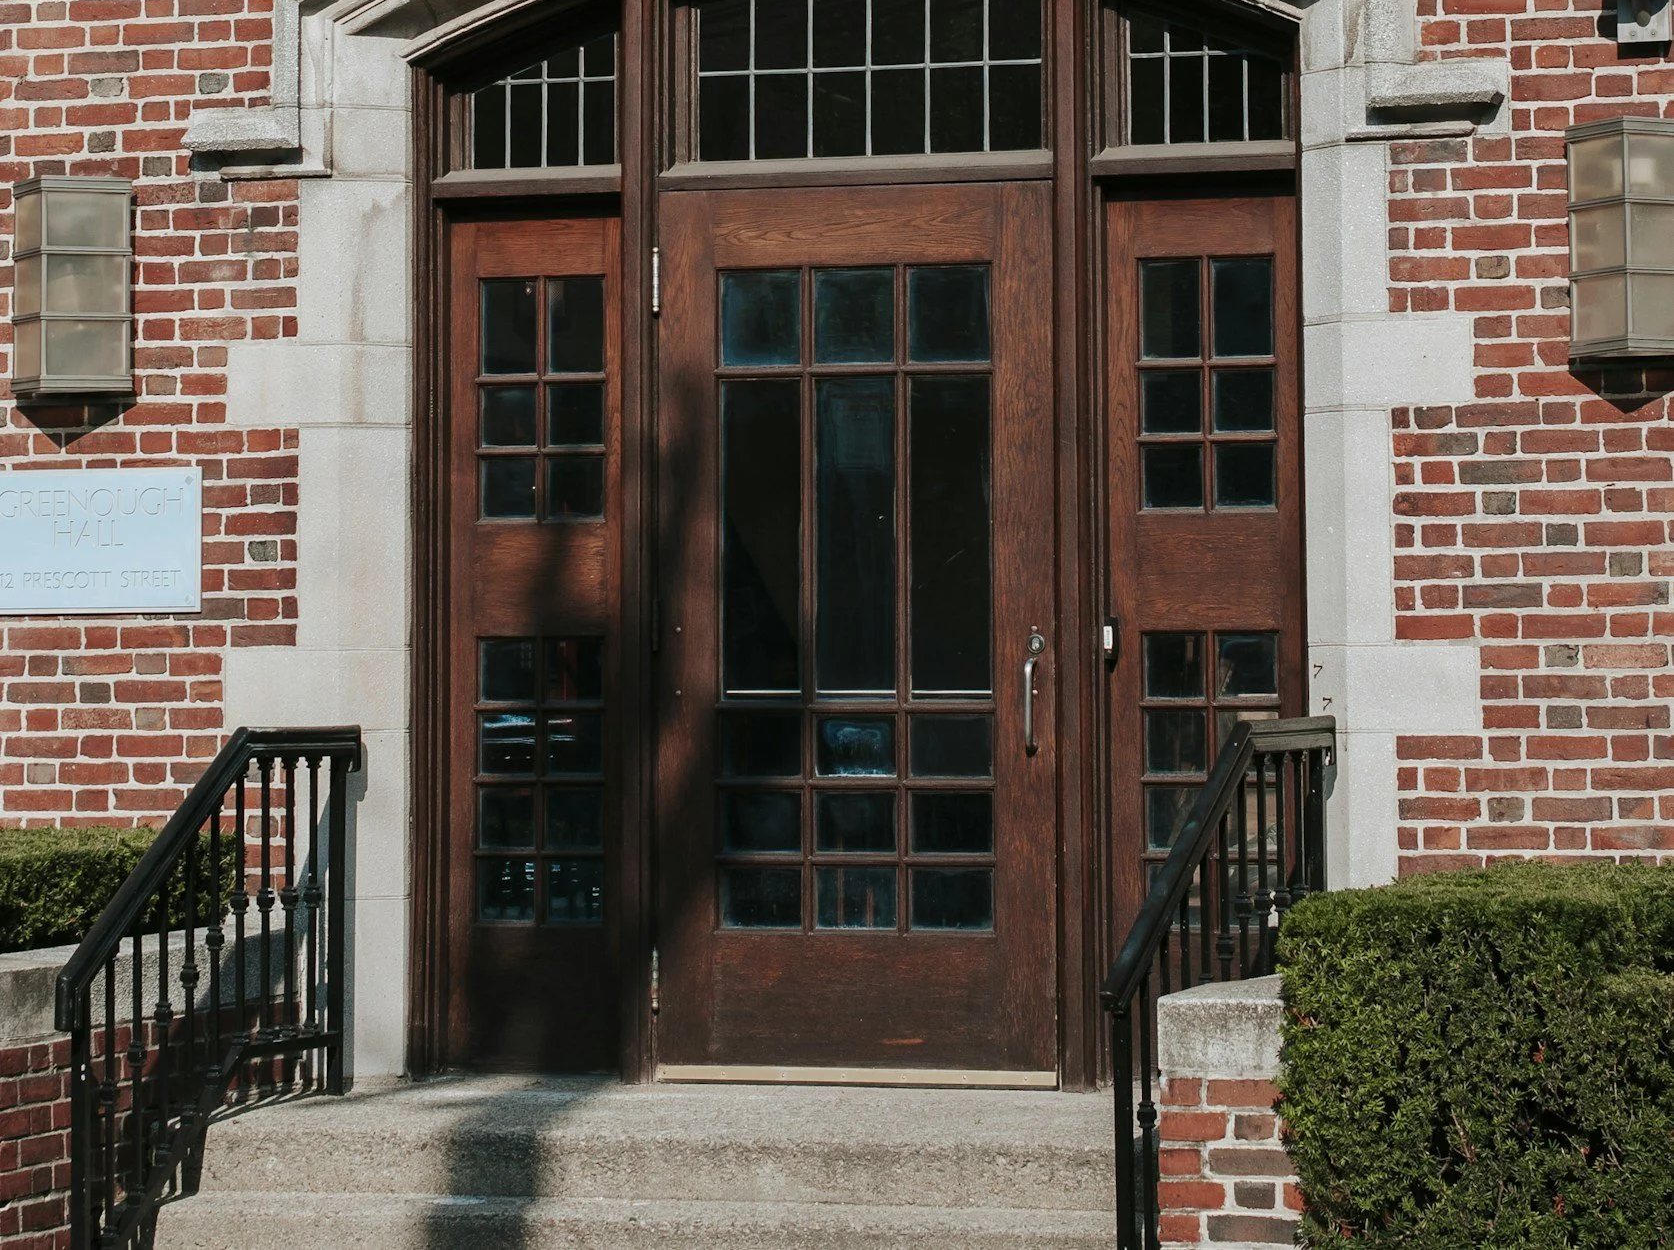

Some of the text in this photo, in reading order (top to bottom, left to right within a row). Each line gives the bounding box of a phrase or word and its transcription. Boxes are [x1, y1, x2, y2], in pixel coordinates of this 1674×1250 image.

[0, 487, 183, 517] GREENOUGH
[53, 520, 124, 547] HALL
[23, 571, 112, 588] PRESCOTT
[120, 570, 181, 587] STREET
